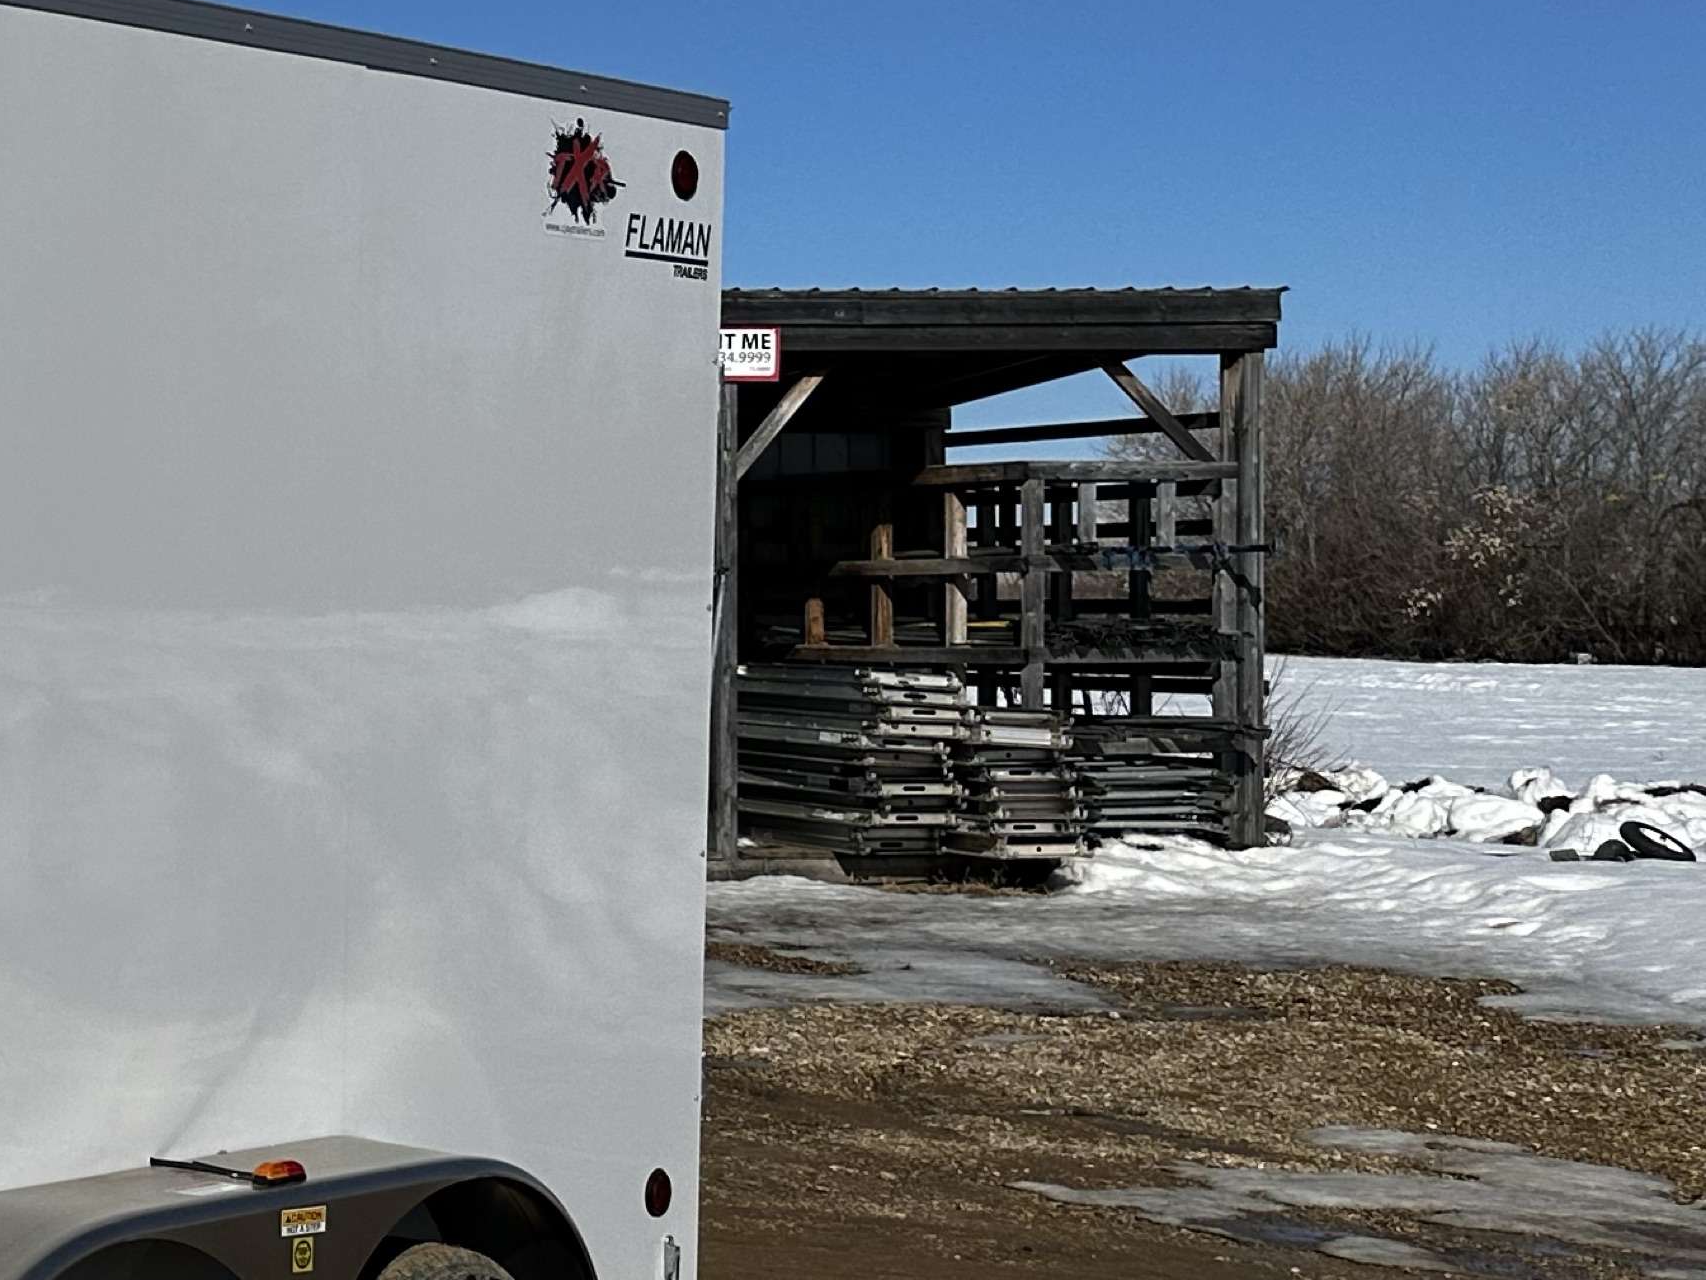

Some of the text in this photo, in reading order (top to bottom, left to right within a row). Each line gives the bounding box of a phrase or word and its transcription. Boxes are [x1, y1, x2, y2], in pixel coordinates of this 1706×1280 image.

[626, 213, 712, 257] FLAMAN
[719, 333, 772, 350] T ME
